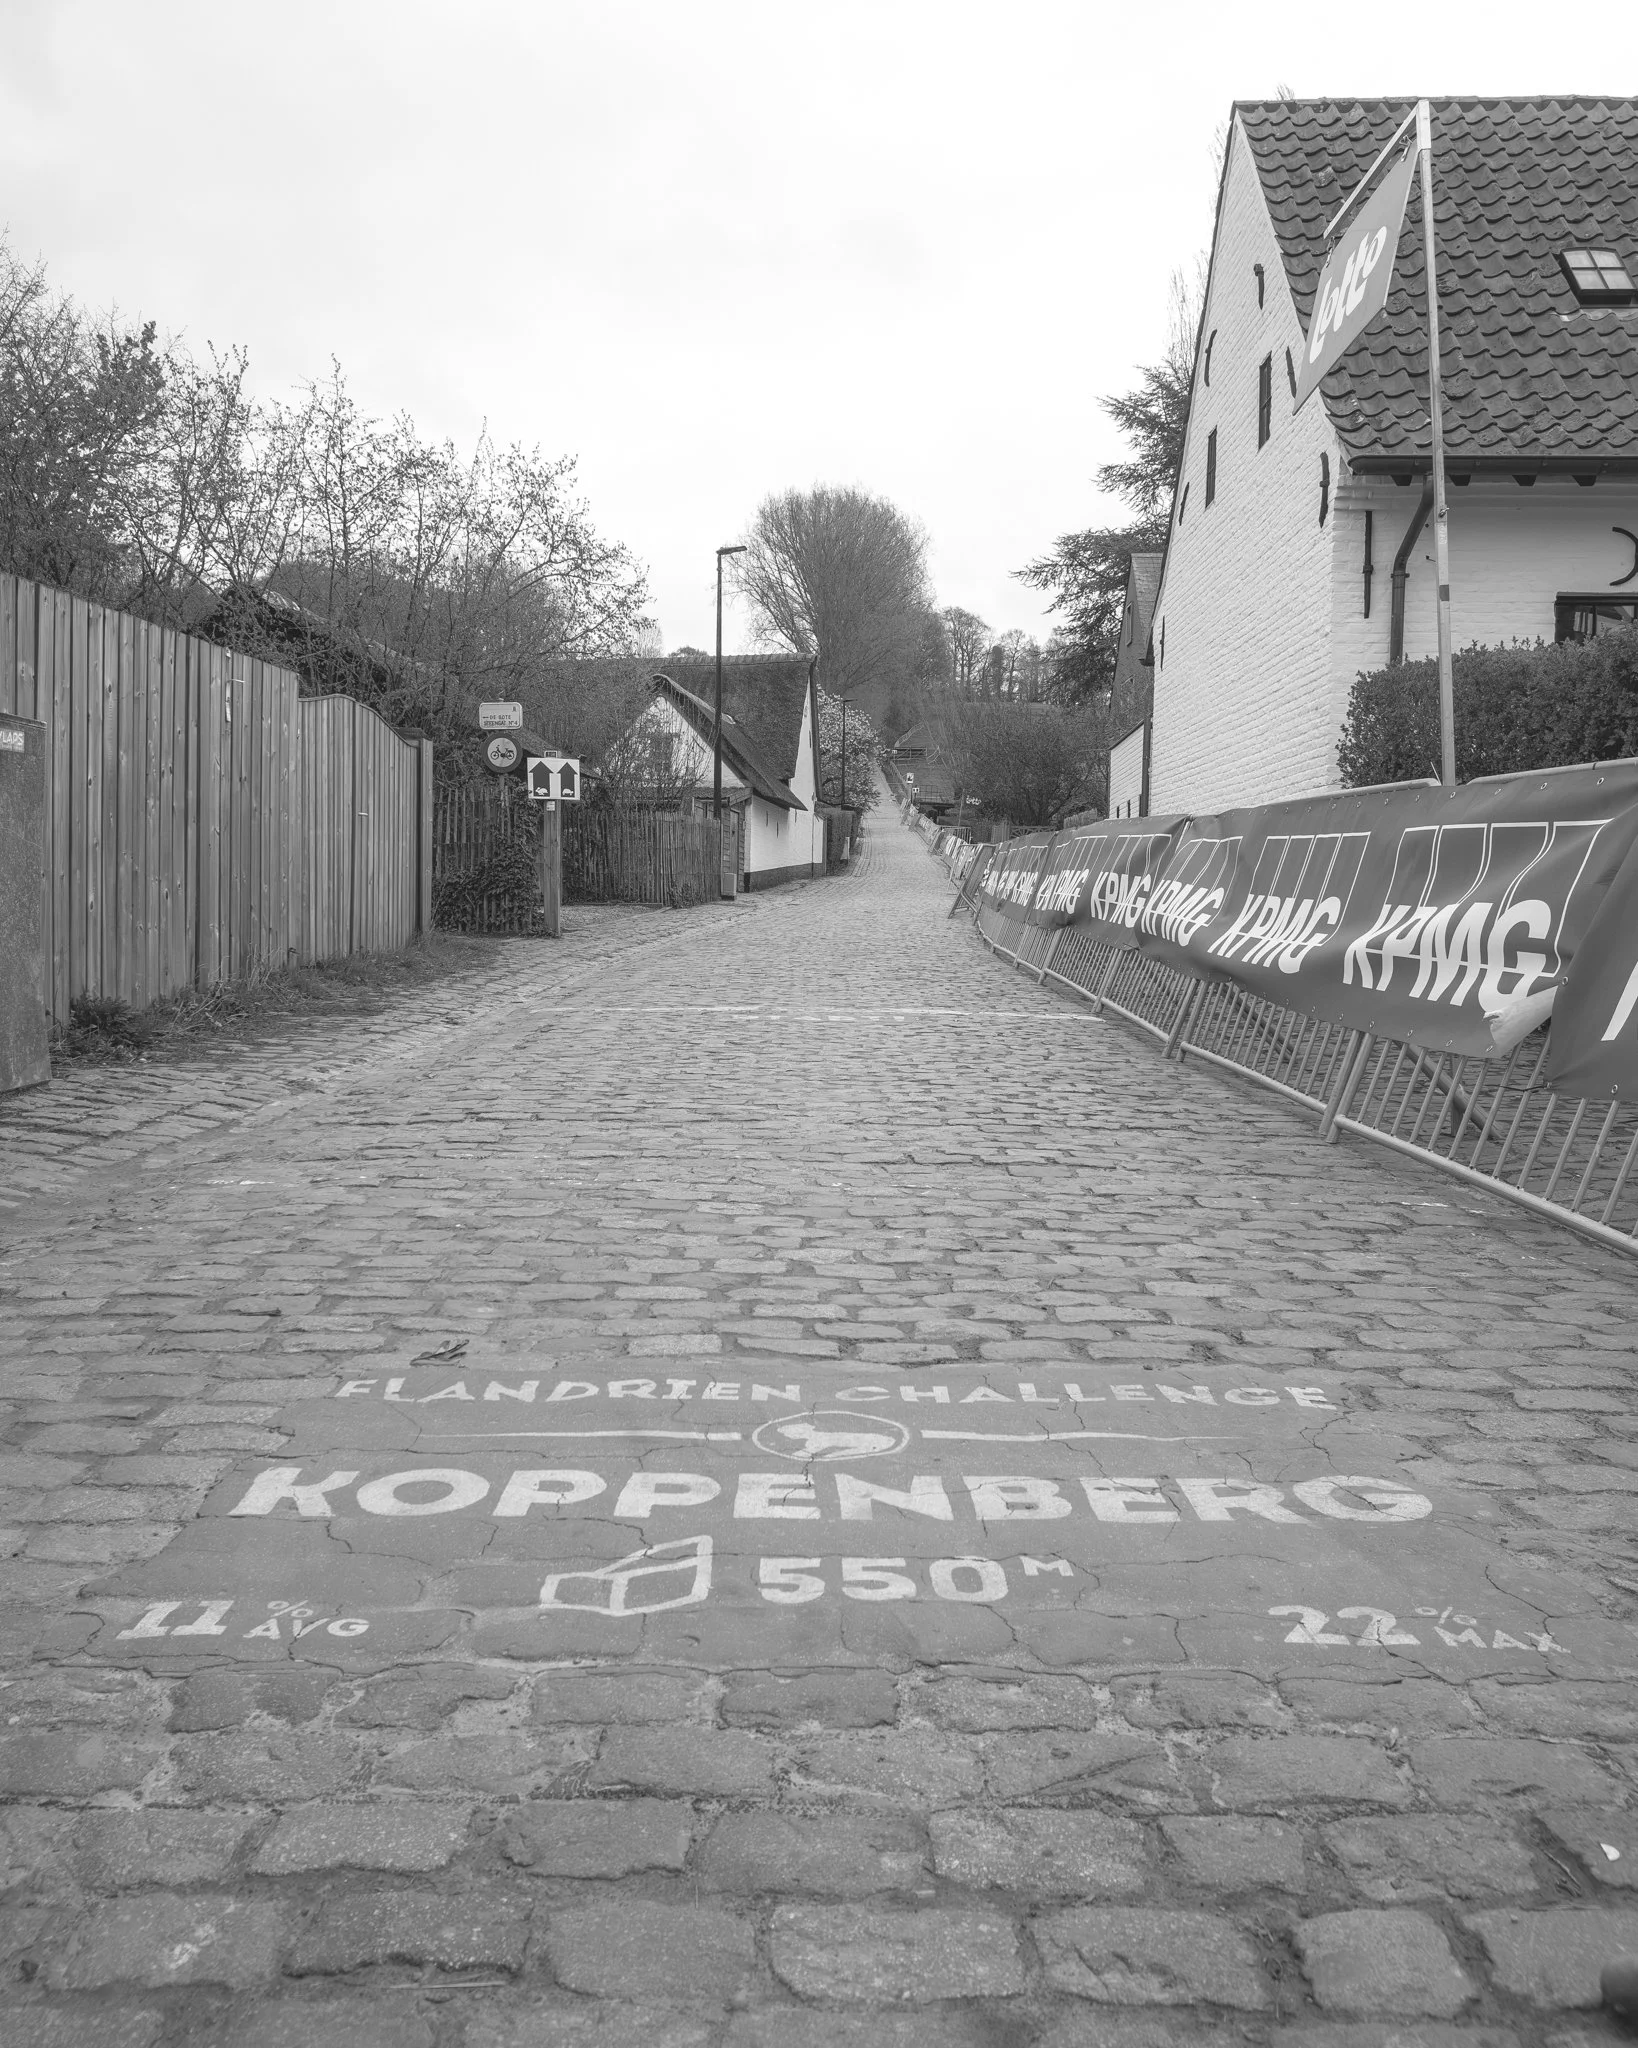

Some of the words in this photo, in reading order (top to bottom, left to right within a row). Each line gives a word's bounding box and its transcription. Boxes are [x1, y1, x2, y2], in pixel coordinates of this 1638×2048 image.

[1309, 225, 1387, 364] lotto
[1091, 871, 1152, 928] KPMG
[1141, 879, 1225, 947] KPMG
[1207, 893, 1341, 974] KPMG
[1342, 899, 1551, 1014] KPMG
[336, 1378, 801, 1402] FLANDRIEN
[836, 1383, 1337, 1409] CHALLENGE
[228, 1467, 1434, 1525] KOPPENBERG
[759, 1556, 1009, 1602] 550
[116, 1600, 236, 1640] 11
[243, 1618, 370, 1640] AVG
[1268, 1605, 1422, 1646] 22
[1433, 1626, 1572, 1653] MAX
